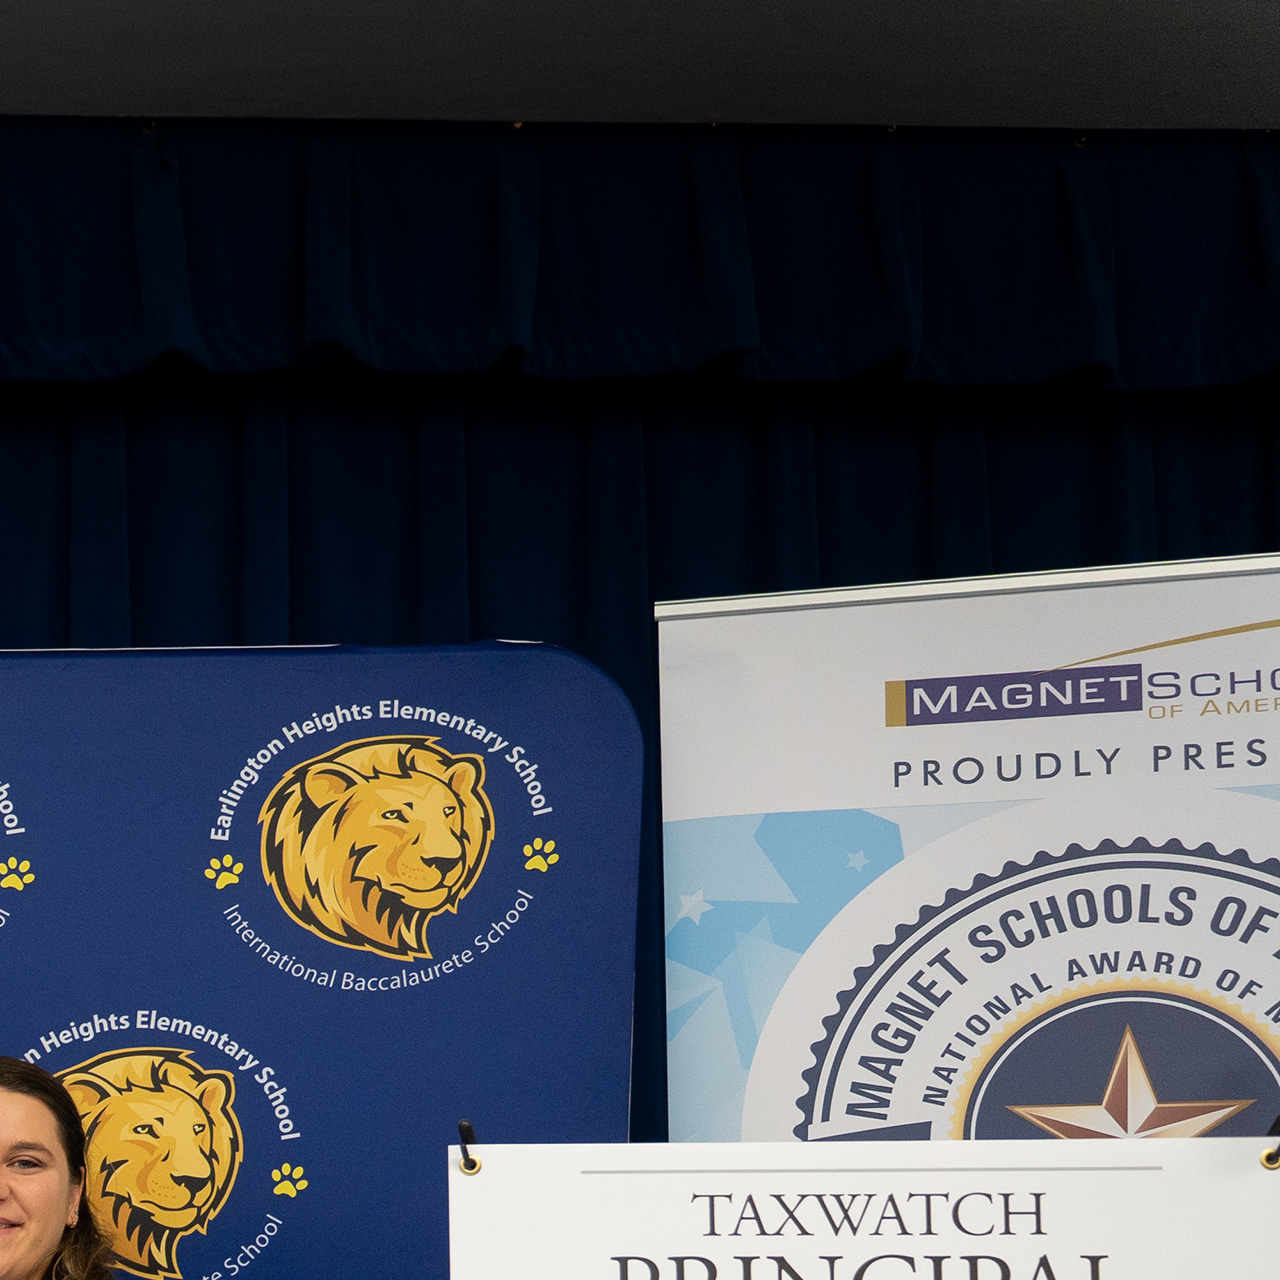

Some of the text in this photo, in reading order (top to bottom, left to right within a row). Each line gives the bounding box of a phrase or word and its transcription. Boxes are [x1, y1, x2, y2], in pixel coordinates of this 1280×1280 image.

[912, 673, 1139, 716] MAGNET
[1148, 704, 1184, 720] OF
[209, 699, 553, 841] Earlington Heights Elementary School
[893, 738, 1268, 787] PROUDLY PRES
[223, 889, 534, 992] International Baccalaurete School
[845, 883, 1280, 1121] MAGNET SCHOOLS OF
[922, 950, 1264, 1107] NATIONAL AWARD OF
[39, 1010, 301, 1141] Heights Elementary School
[223, 1213, 283, 1277] School
[691, 1191, 1048, 1238] TAXWATCH
